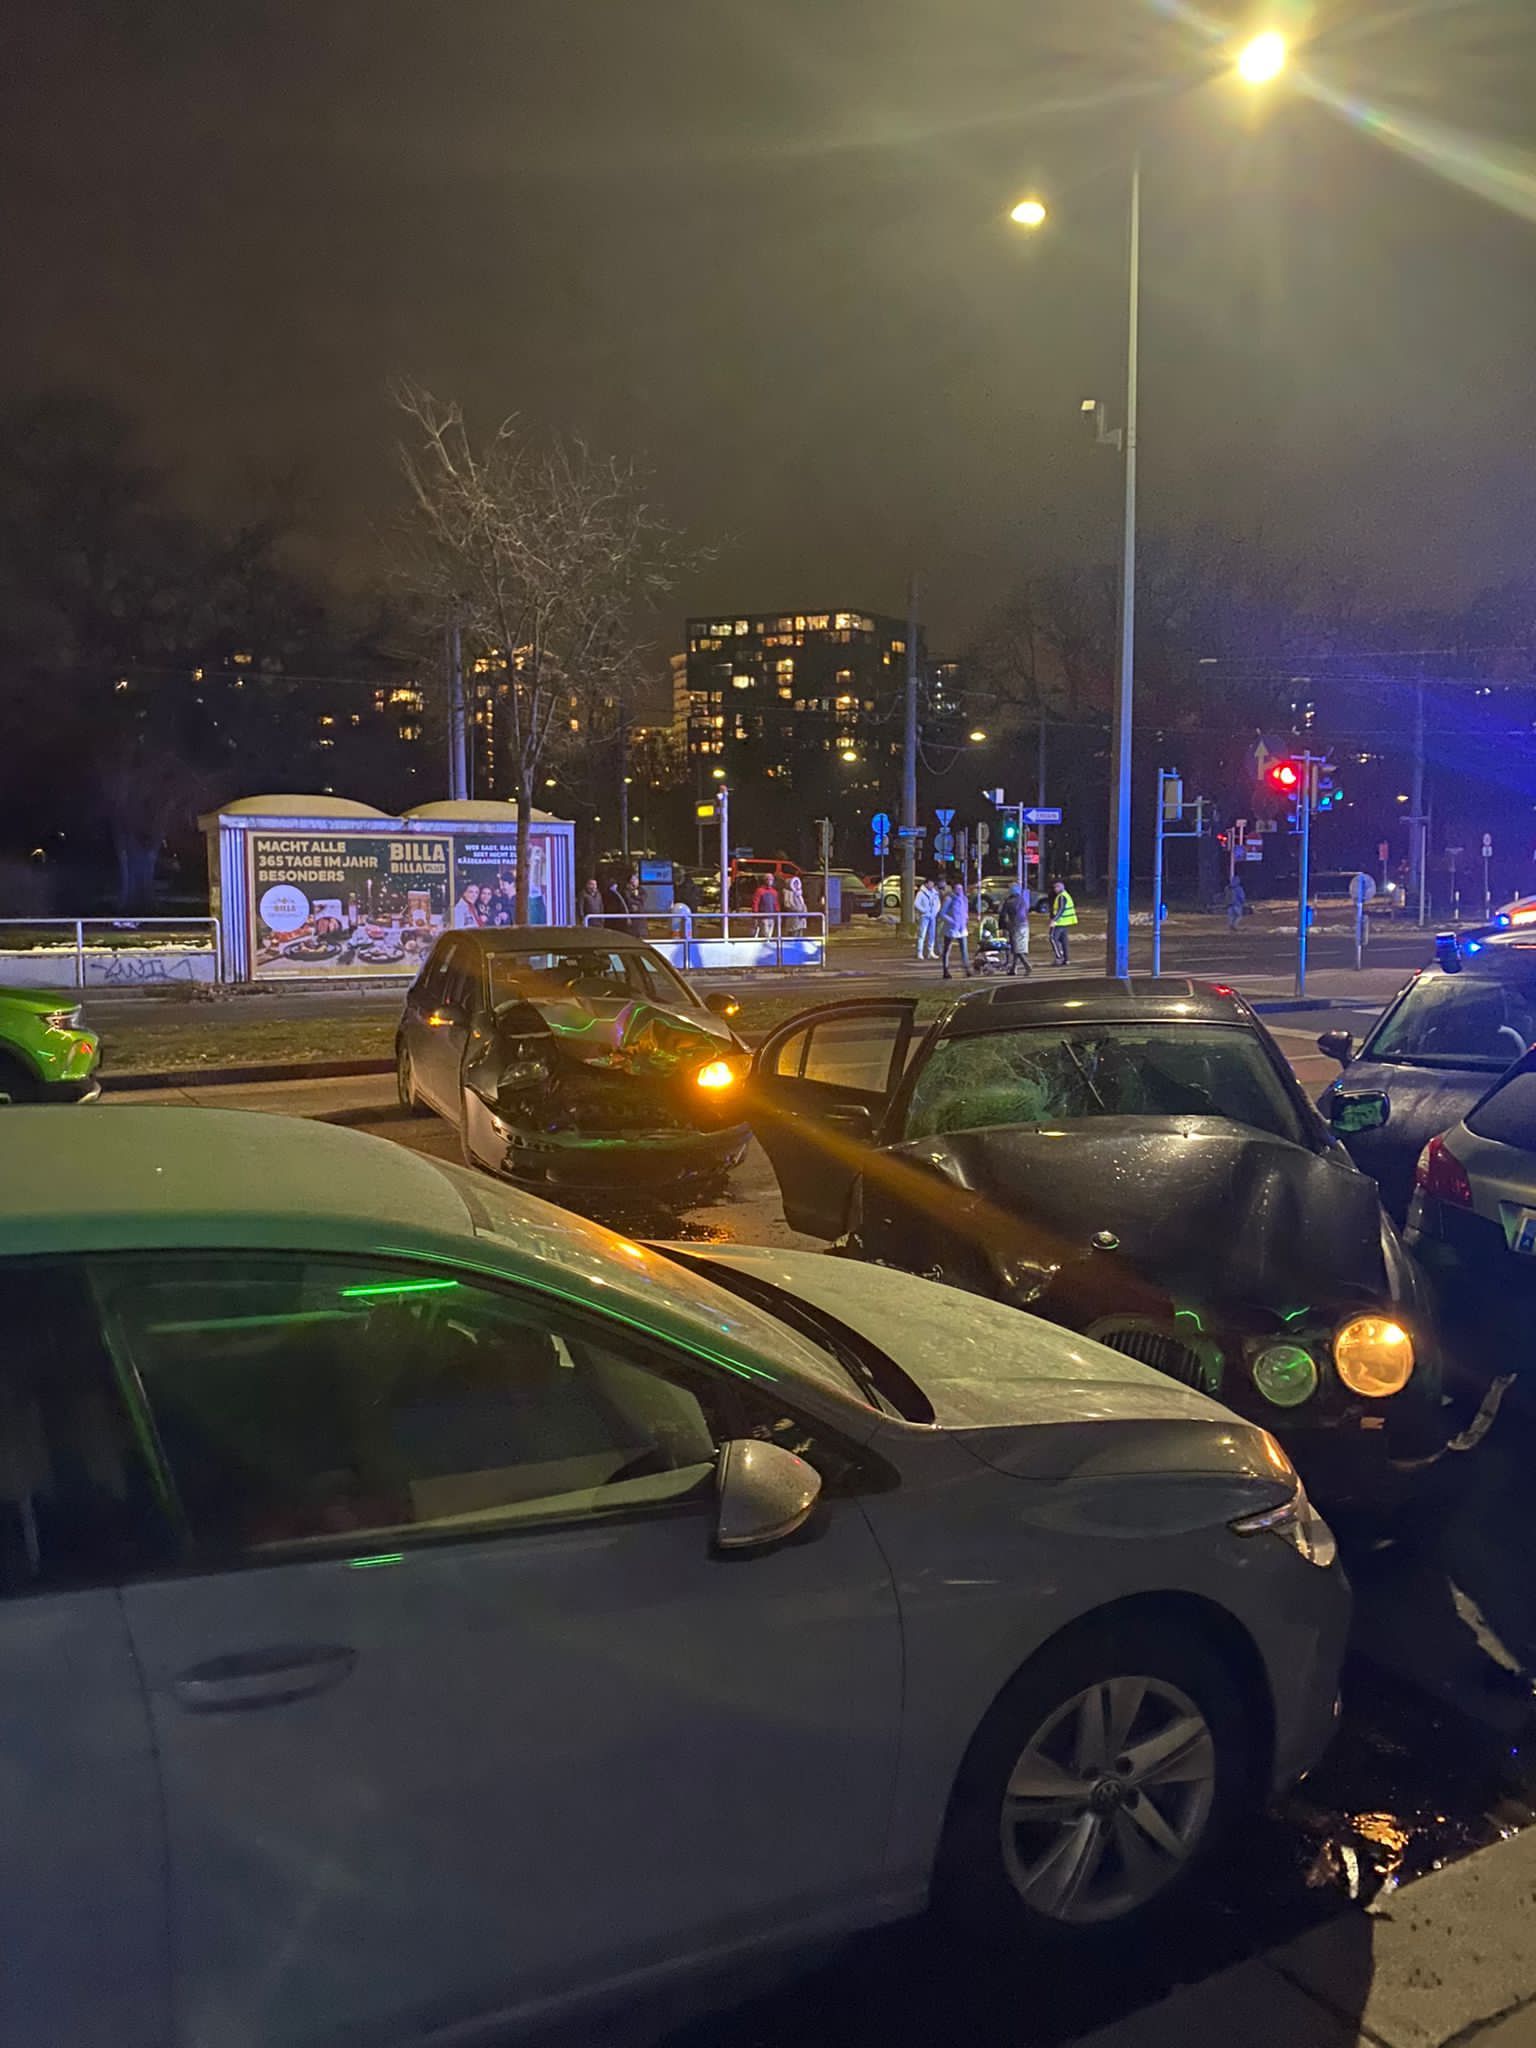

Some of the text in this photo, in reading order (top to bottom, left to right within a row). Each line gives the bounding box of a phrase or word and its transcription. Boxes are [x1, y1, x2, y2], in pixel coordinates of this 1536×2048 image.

[257, 841, 346, 853] MACHT ALLE
[390, 843, 445, 861] BILLA
[259, 855, 378, 868] 365 TAGE IM JAHR
[391, 862, 424, 874] BILLA
[259, 870, 345, 882] BESONDERS
